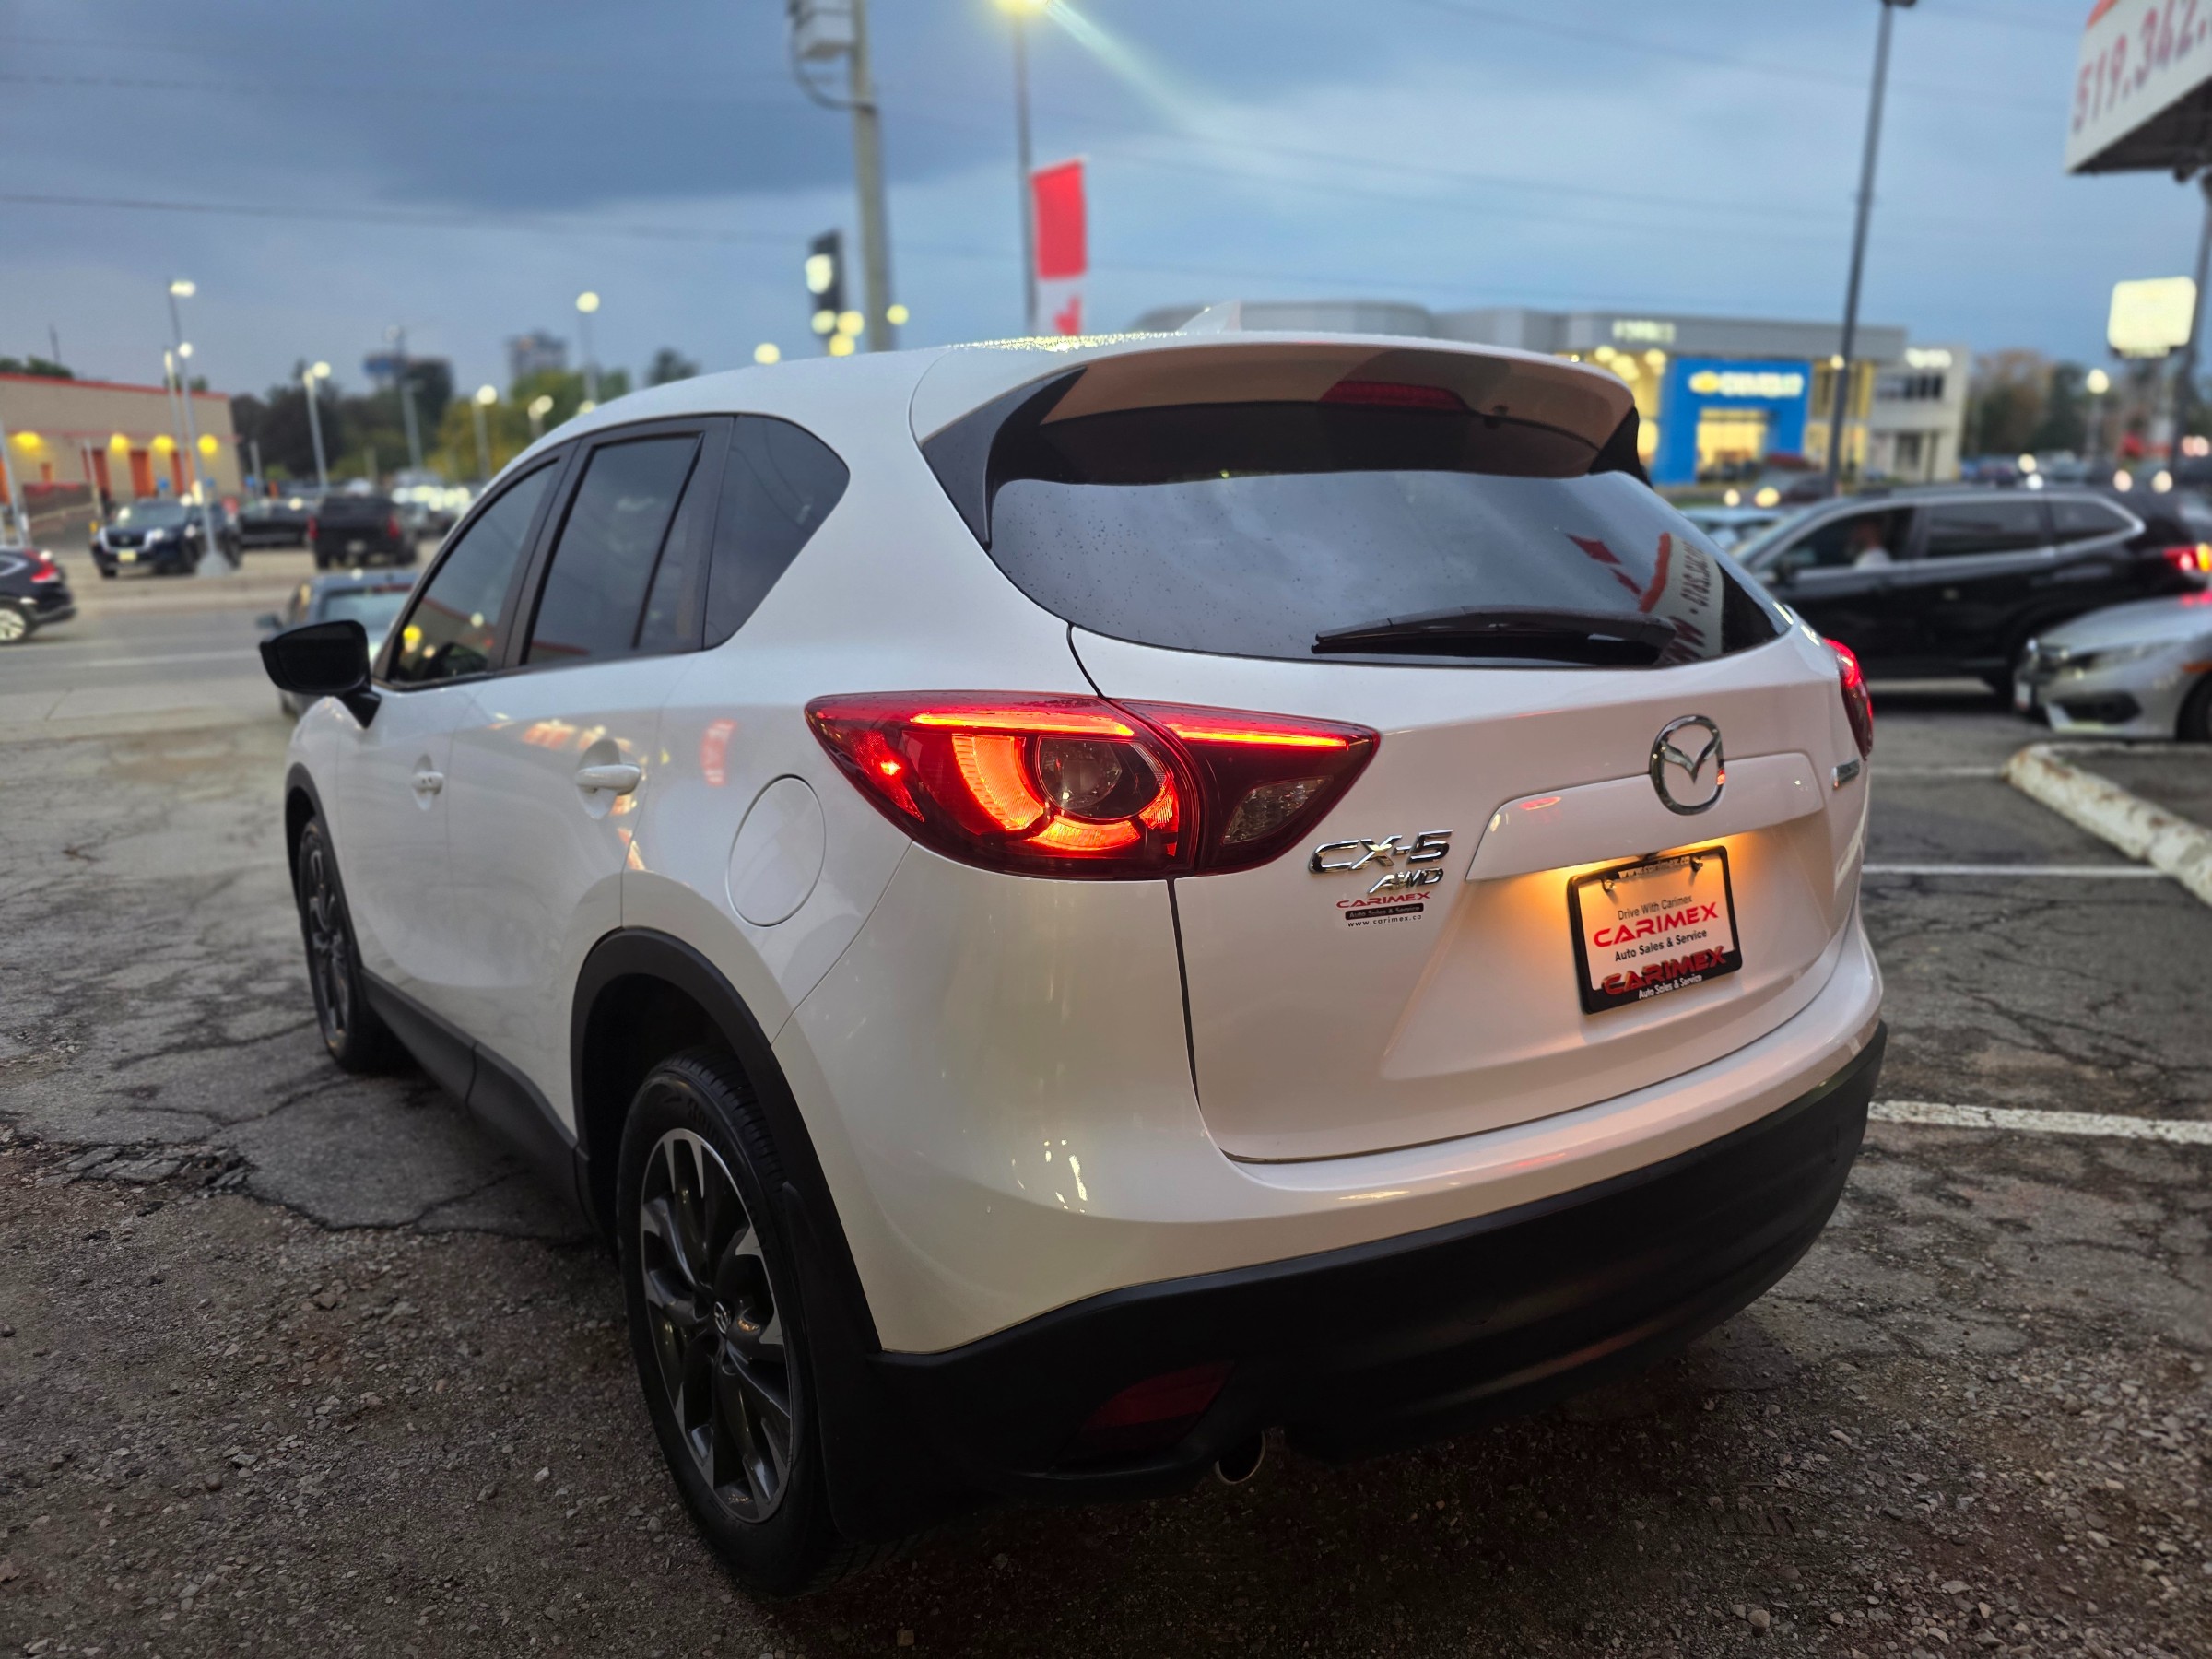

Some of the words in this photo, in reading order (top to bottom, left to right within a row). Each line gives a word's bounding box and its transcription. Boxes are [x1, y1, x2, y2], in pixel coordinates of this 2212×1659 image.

[1308, 829, 1453, 874] CX-5
[1367, 866, 1444, 895] AWD
[1336, 891, 1430, 909] CARIMEX
[1349, 911, 1366, 919] Auto
[1395, 904, 1420, 912] Service
[1618, 907, 1640, 921] Drive
[1641, 902, 1660, 914] With
[1661, 895, 1693, 910] Carimex
[1594, 902, 1719, 947] CARIMEX
[1615, 949, 1637, 962] Auto
[1639, 942, 1665, 956] Sales
[1666, 937, 1674, 947] &
[1676, 929, 1708, 946] Service
[1601, 945, 1727, 996] CARIMEX
[1638, 988, 1655, 1000] Auto
[1654, 982, 1674, 994] Sales
[1674, 979, 1680, 989] &
[1680, 973, 1703, 987] Service
